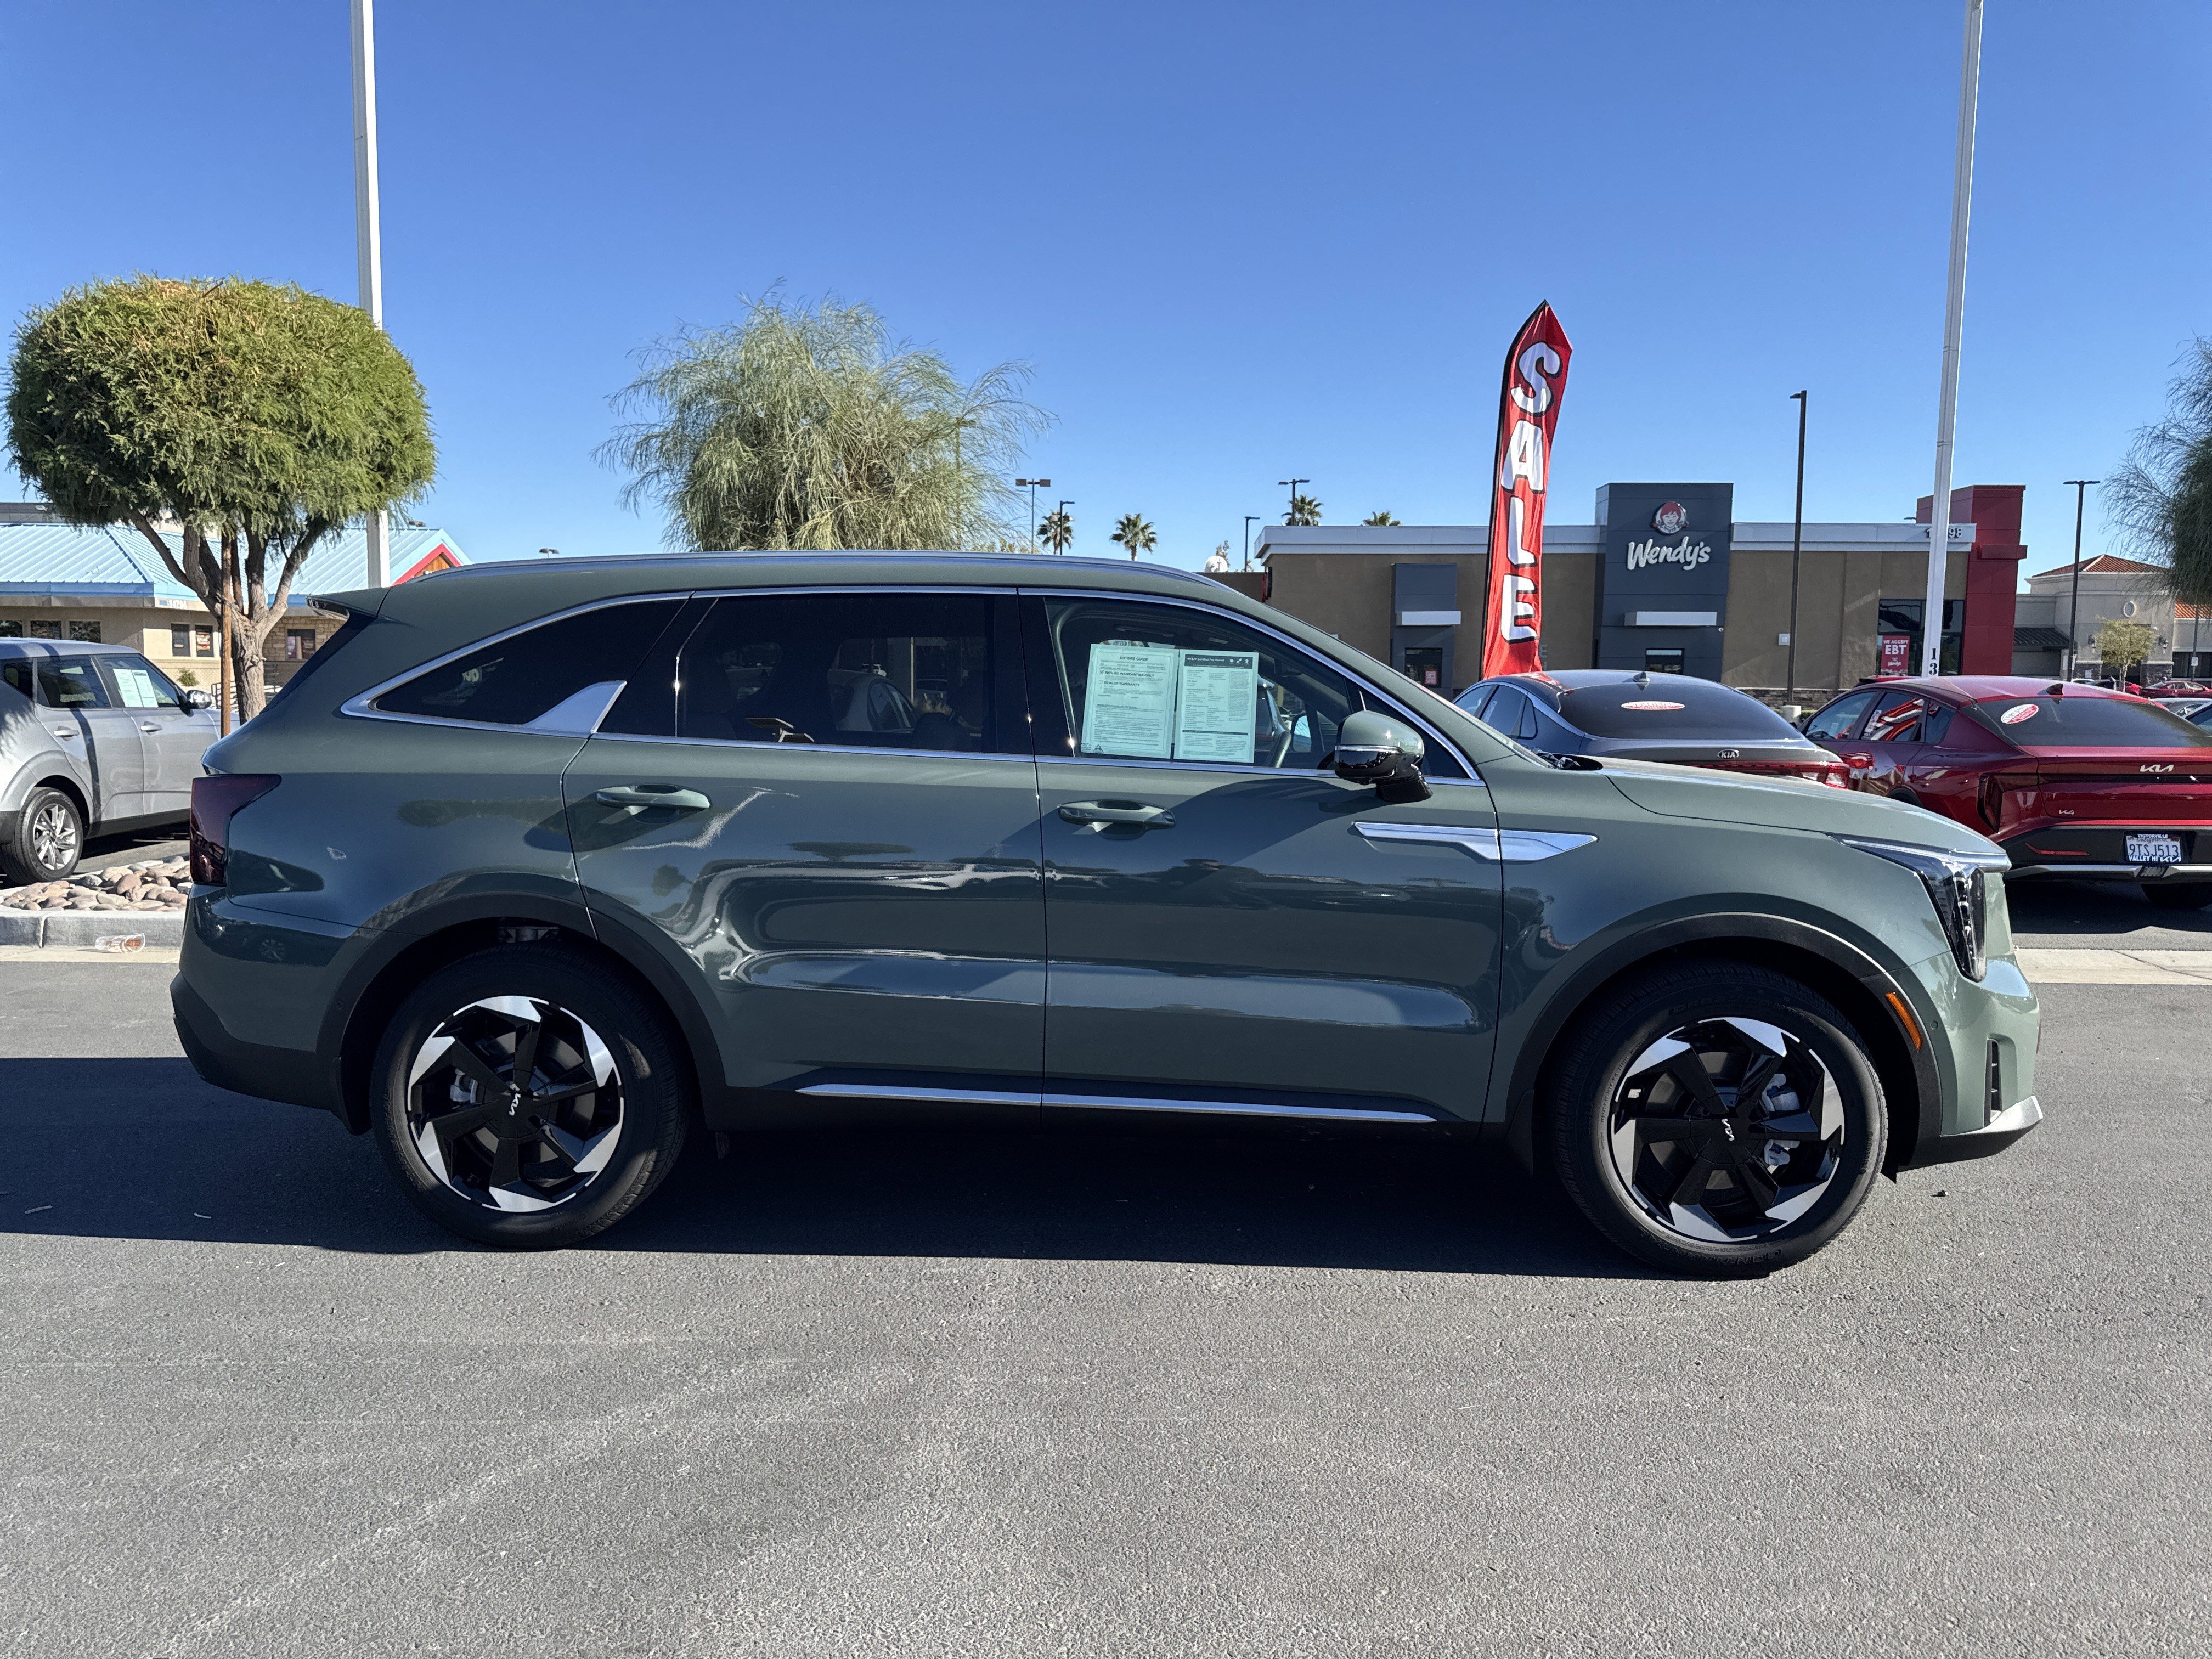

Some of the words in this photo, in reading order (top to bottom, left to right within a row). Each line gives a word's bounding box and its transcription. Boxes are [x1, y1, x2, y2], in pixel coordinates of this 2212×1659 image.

[1500, 342, 1561, 641] SALE
[1927, 527, 1962, 538] 198
[1627, 536, 1711, 570] Wendy's
[1885, 645, 1906, 655] EBT
[1929, 648, 1938, 675] 13
[2129, 844, 2179, 857] 9TSJ513
